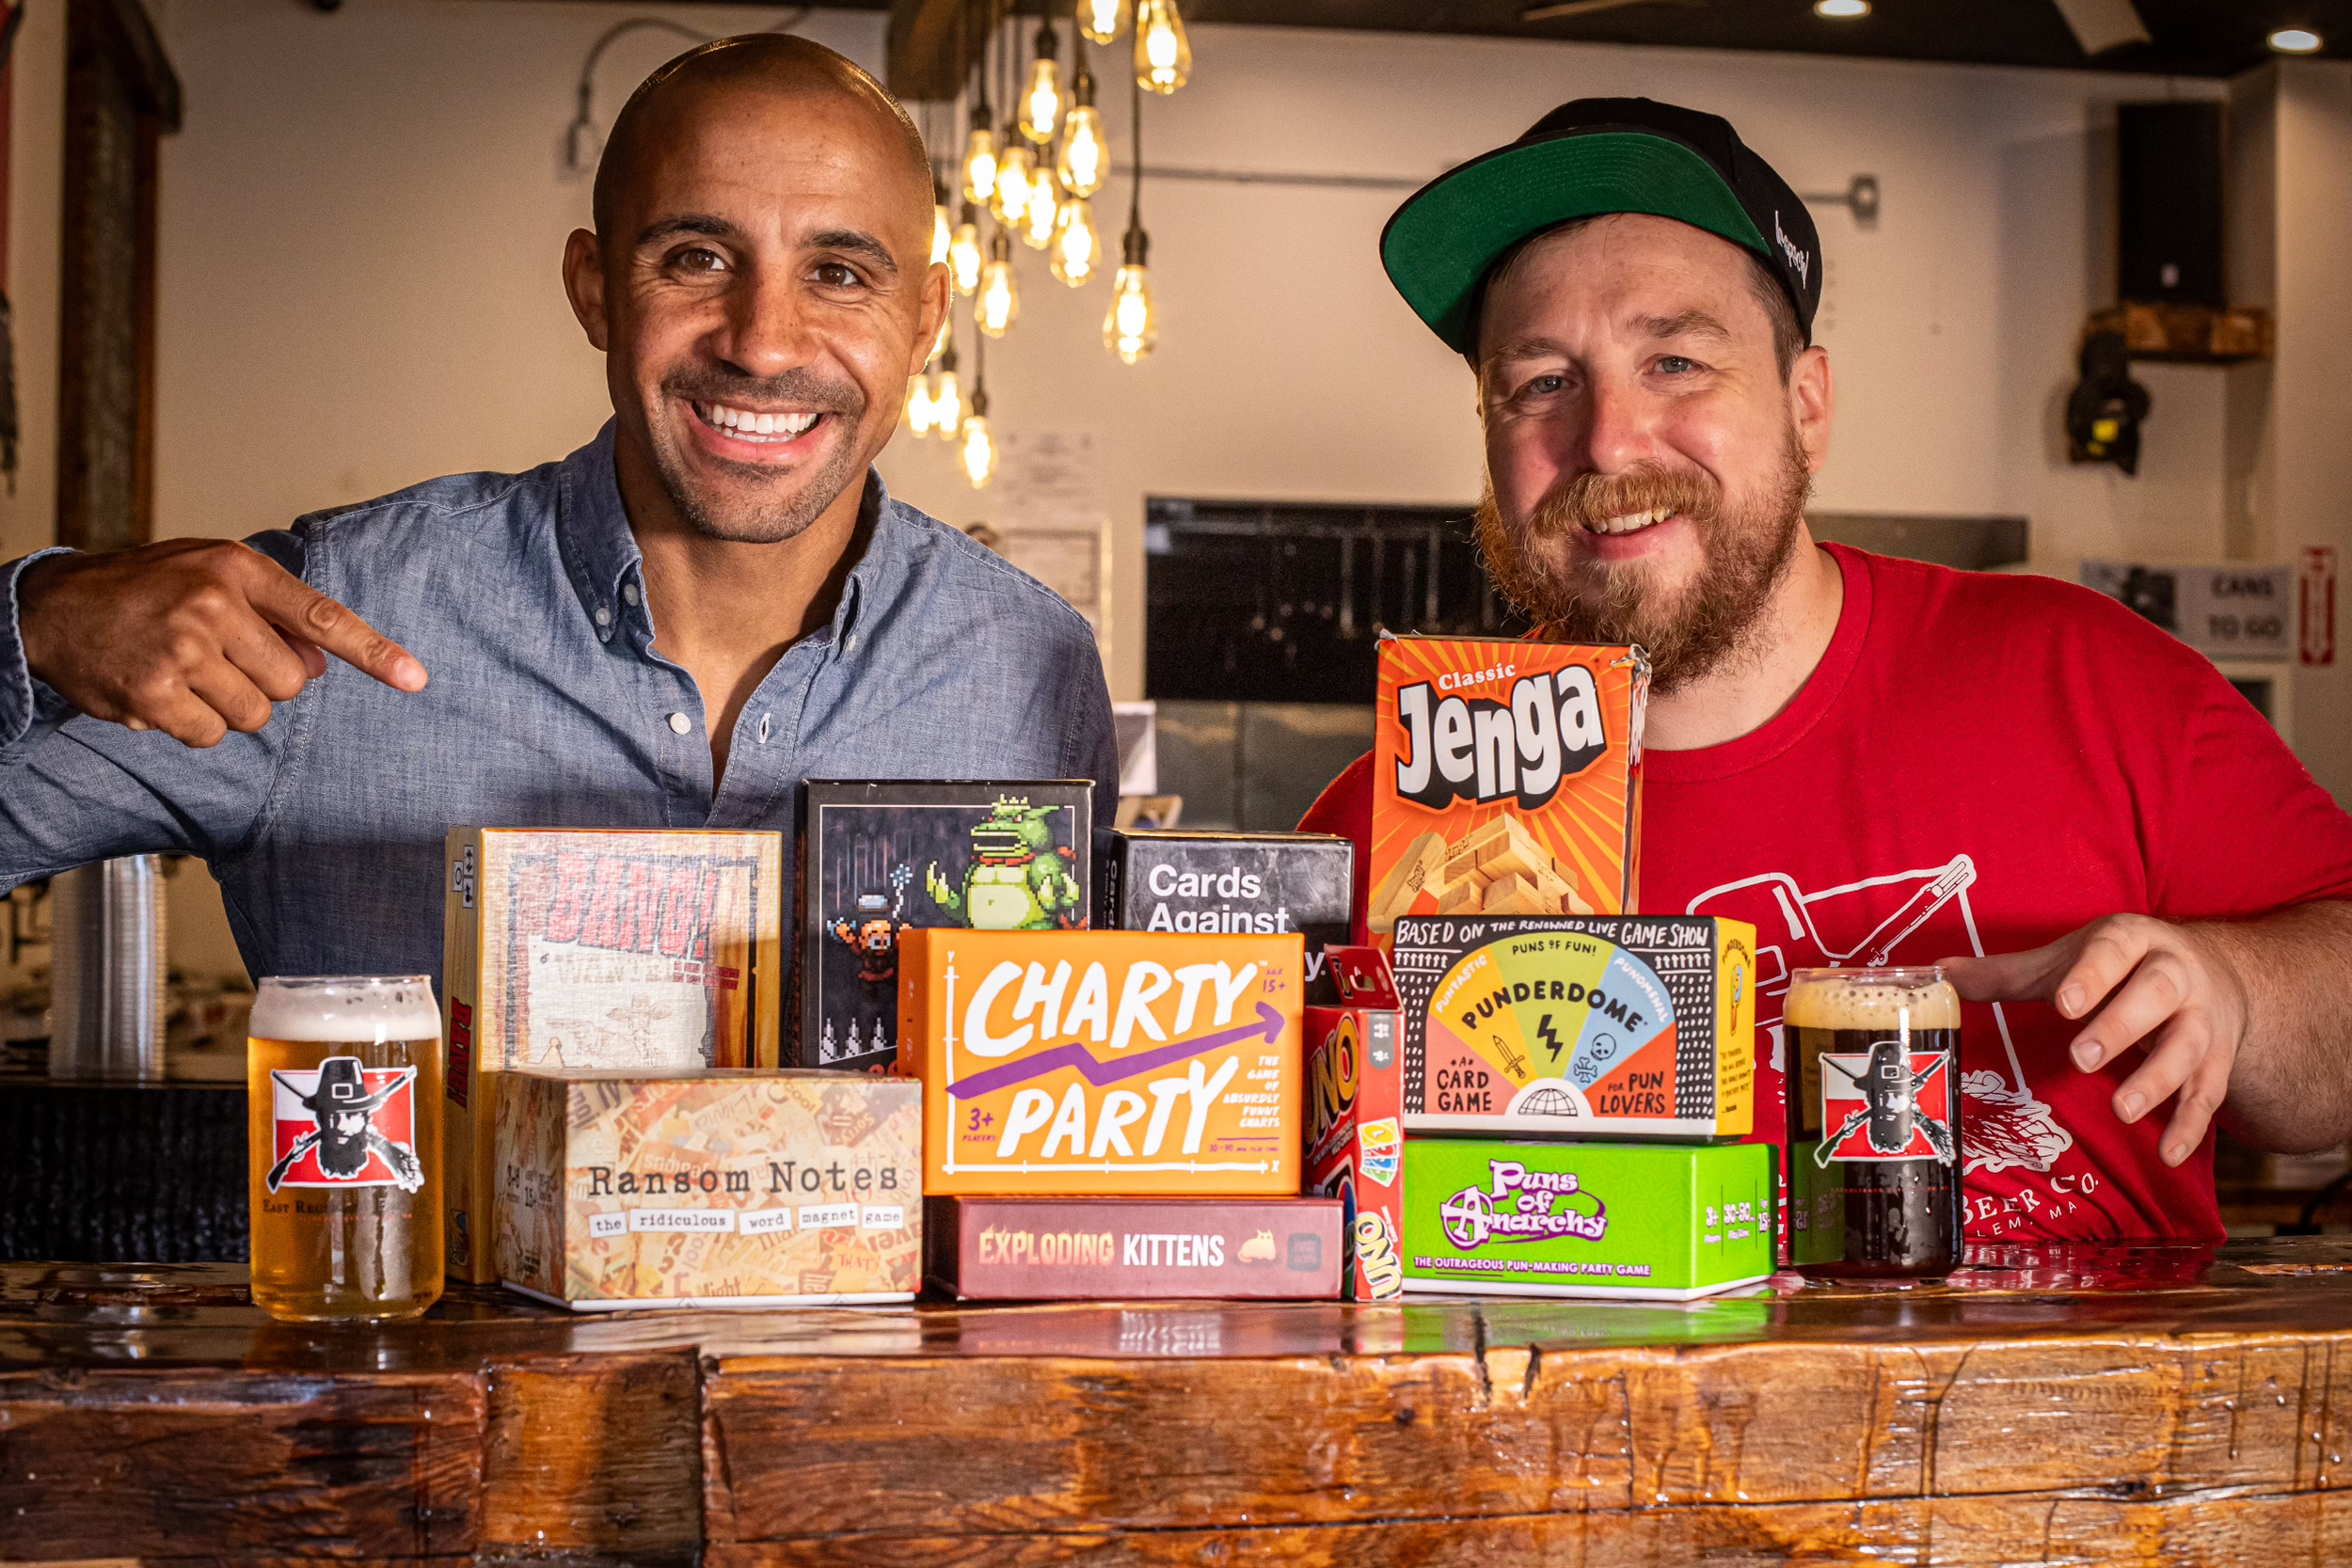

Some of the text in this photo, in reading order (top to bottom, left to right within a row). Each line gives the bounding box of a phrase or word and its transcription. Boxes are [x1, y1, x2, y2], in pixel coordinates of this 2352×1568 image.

[2210, 615, 2282, 640] TO GO
[1438, 662, 1516, 690] Classic
[1397, 663, 1604, 800] Jenga
[1149, 863, 1262, 899] Cards
[544, 849, 720, 959] BANG!
[1146, 902, 1290, 933] Against
[1396, 920, 1708, 947] BASED ON THE RENOWNED LIVE GAME SHOW
[1512, 940, 1597, 957] PUNS OF FUN!
[1263, 979, 1286, 993] 15+
[1435, 954, 1488, 1013] PUNTASTIC
[1613, 957, 1669, 1023] PUNOMENAL
[963, 959, 1258, 1058] CHARTY
[1461, 980, 1644, 1033] PUNDERDOME
[1258, 1055, 1280, 1067] THE
[1247, 1069, 1279, 1080] GAME
[1264, 1081, 1280, 1091] OF
[1437, 1069, 1489, 1090] CARD
[1608, 1071, 1665, 1092] FOR PUN
[995, 1054, 1241, 1159] PARTY
[1222, 1093, 1280, 1104] ABSURDLY
[1438, 1092, 1492, 1113] GAME
[1599, 1093, 1666, 1115] LOVERS
[968, 1107, 994, 1132] 3+
[1239, 1117, 1280, 1128] CHARTS
[1242, 1106, 1280, 1117] FUNNY
[588, 1165, 751, 1196] Ransom
[770, 1161, 898, 1194] Notes
[1489, 1159, 1579, 1198] Puns
[1517, 1190, 1554, 1214] of
[2049, 1201, 2076, 1219] MA
[596, 1209, 900, 1231] the ridiculous word magnet game
[1440, 1185, 1608, 1247] Anarchy
[978, 1229, 1225, 1268] EXPLODING KITTENS
[1355, 1211, 1404, 1299] UNO
[838, 1254, 874, 1271] THAT
[1414, 1257, 1650, 1276] THE OUTRAGEOUS PUN-MAKING PARTY GAME
